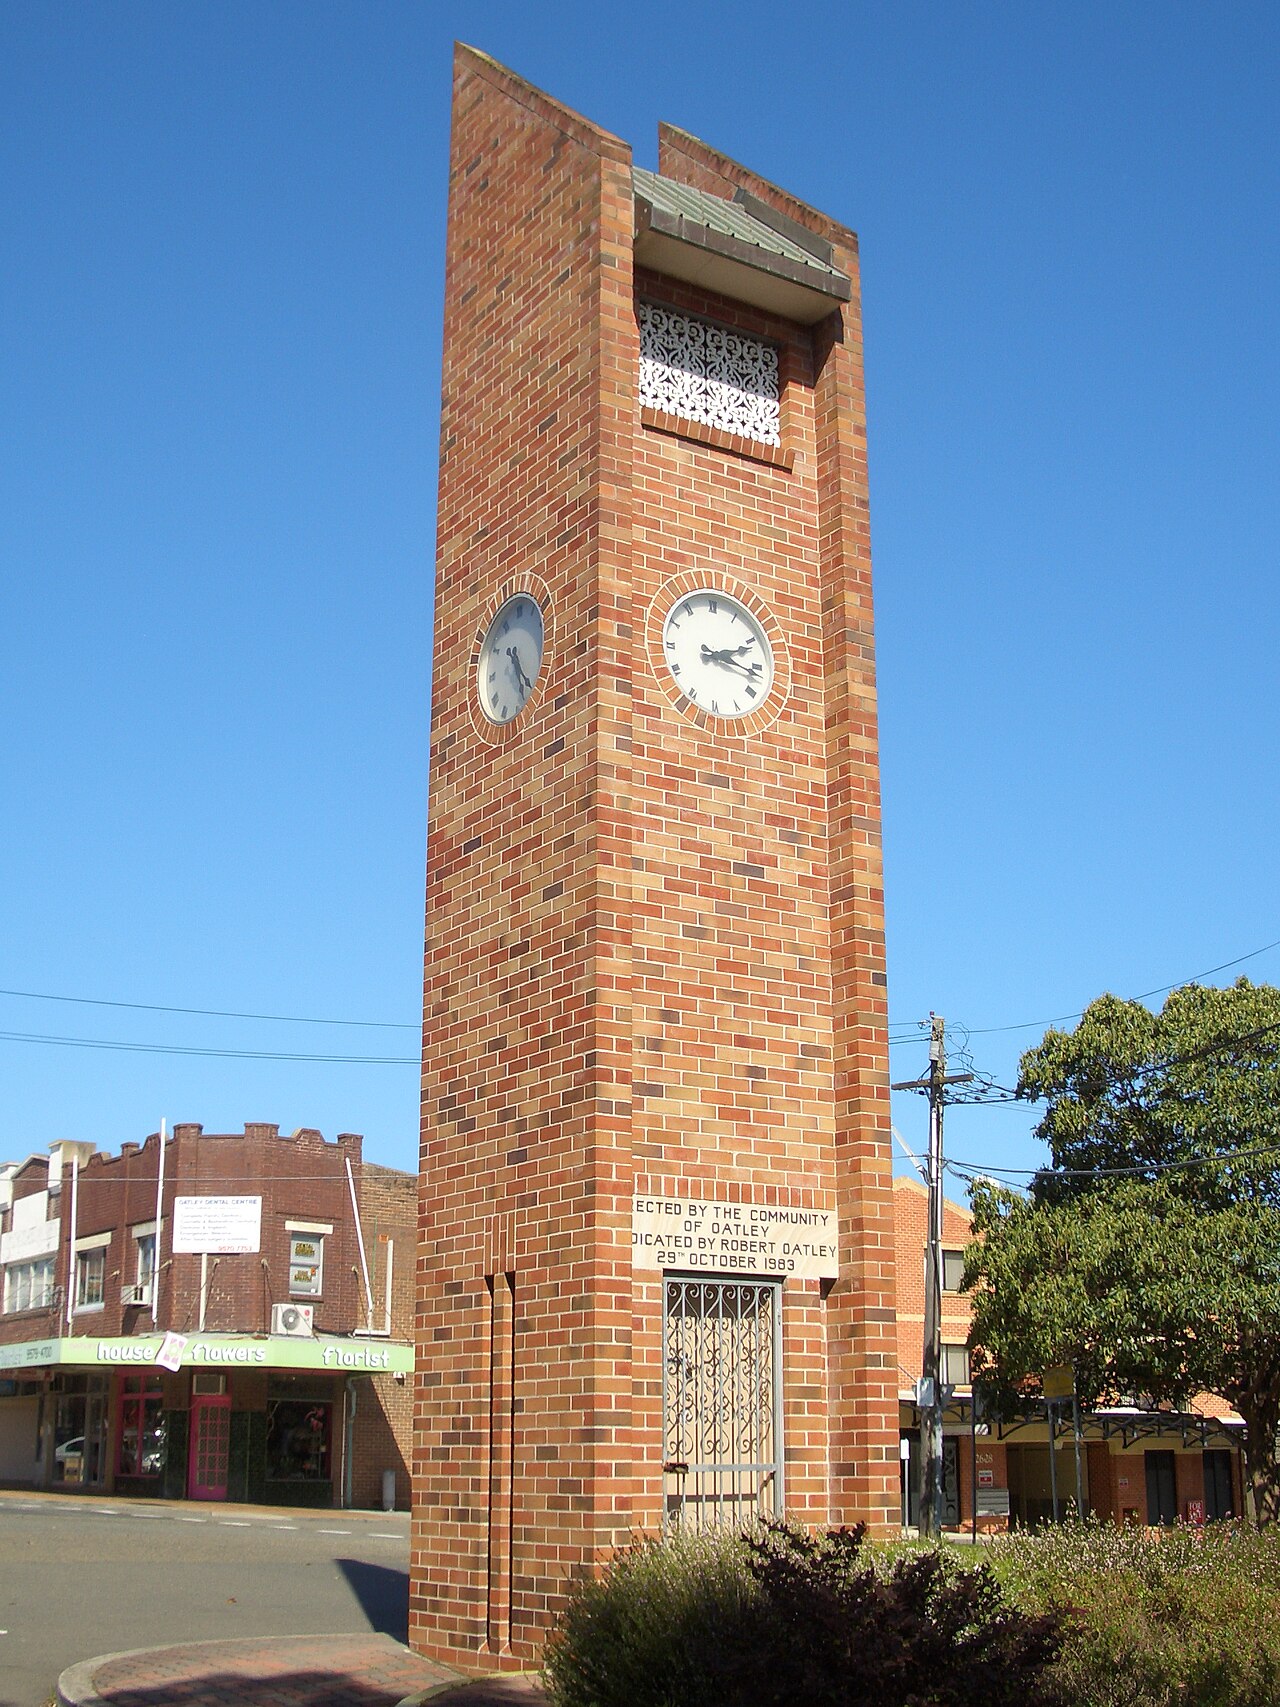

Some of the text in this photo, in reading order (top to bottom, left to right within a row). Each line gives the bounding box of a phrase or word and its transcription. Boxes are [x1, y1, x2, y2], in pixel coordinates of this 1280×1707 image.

[633, 1200, 829, 1226] ECTED BY THE COMMUNITY
[684, 1220, 769, 1237] OF OATLEY
[698, 1237, 716, 1250] BY
[721, 1239, 776, 1253] ROBERT
[783, 1243, 837, 1258] OATLEY
[689, 1253, 757, 1269] OCTOBER
[764, 1257, 795, 1271] 1983
[97, 1341, 154, 1361] house
[191, 1343, 266, 1362] flowers
[322, 1345, 390, 1368] florist
[1189, 1502, 1202, 1511] FOR
